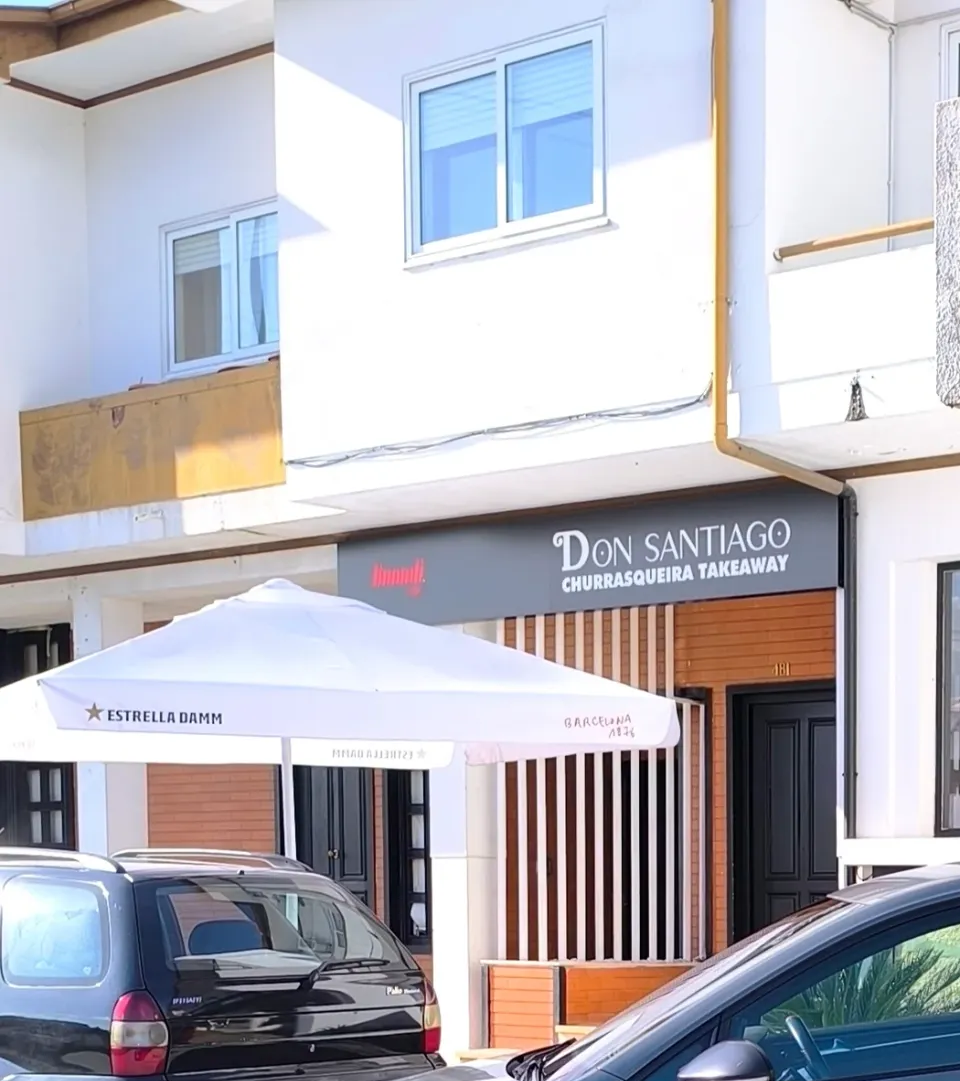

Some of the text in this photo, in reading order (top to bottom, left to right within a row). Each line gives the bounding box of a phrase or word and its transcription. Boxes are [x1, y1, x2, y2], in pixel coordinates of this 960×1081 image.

[552, 518, 791, 572] DON SANTIAGO
[562, 554, 790, 593] CHURRASQUEIRA TAKEAWAY
[107, 709, 223, 725] ESTRELLA DAMM
[564, 713, 632, 729] BARCELONA
[608, 726, 636, 739] 1876
